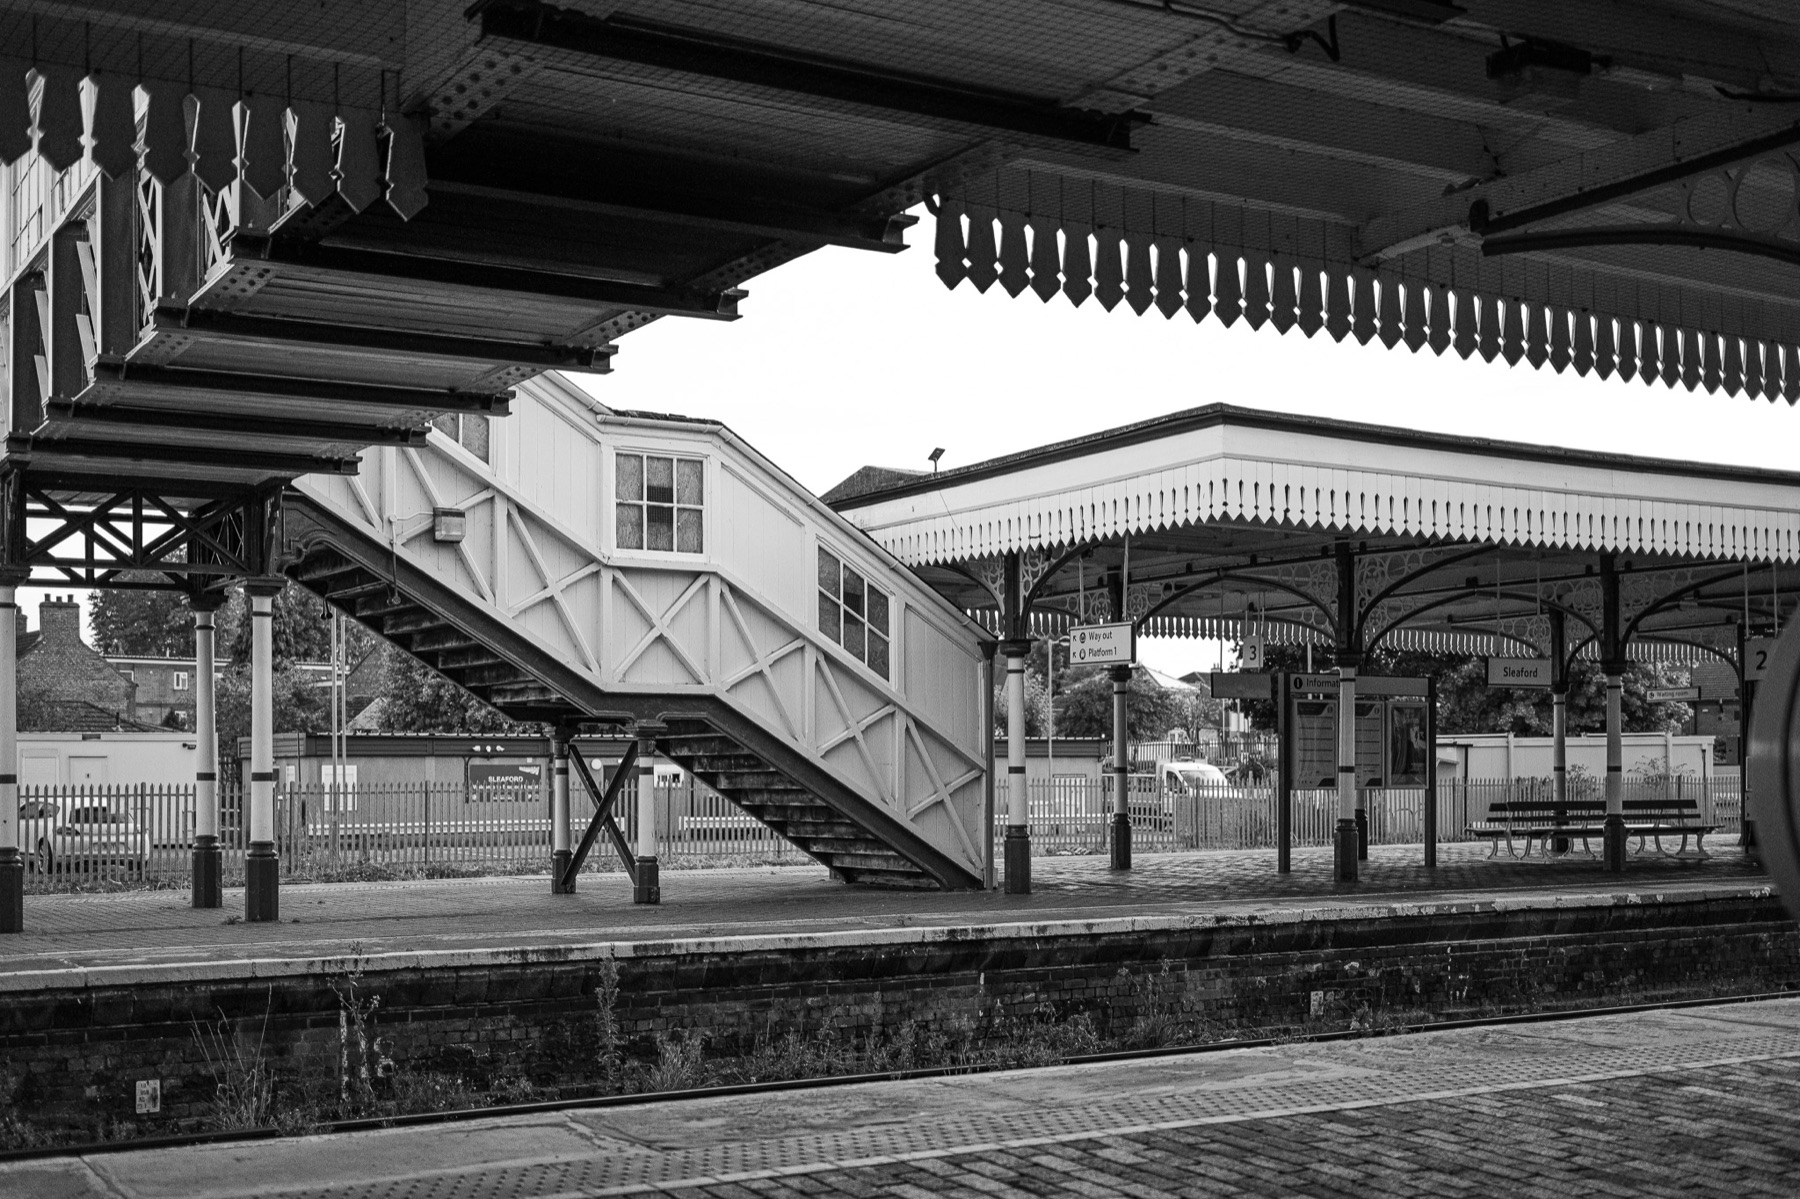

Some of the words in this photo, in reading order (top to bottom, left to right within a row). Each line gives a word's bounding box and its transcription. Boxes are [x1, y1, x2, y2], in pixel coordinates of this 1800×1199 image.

[1088, 631, 1101, 642] Way
[1102, 630, 1113, 640] out
[1088, 647, 1113, 657] Platform
[1114, 646, 1117, 656] 1
[1249, 645, 1257, 661] 3
[1756, 650, 1767, 671] 2
[1503, 666, 1538, 678] Sleaford
[1306, 677, 1340, 688] Informat
